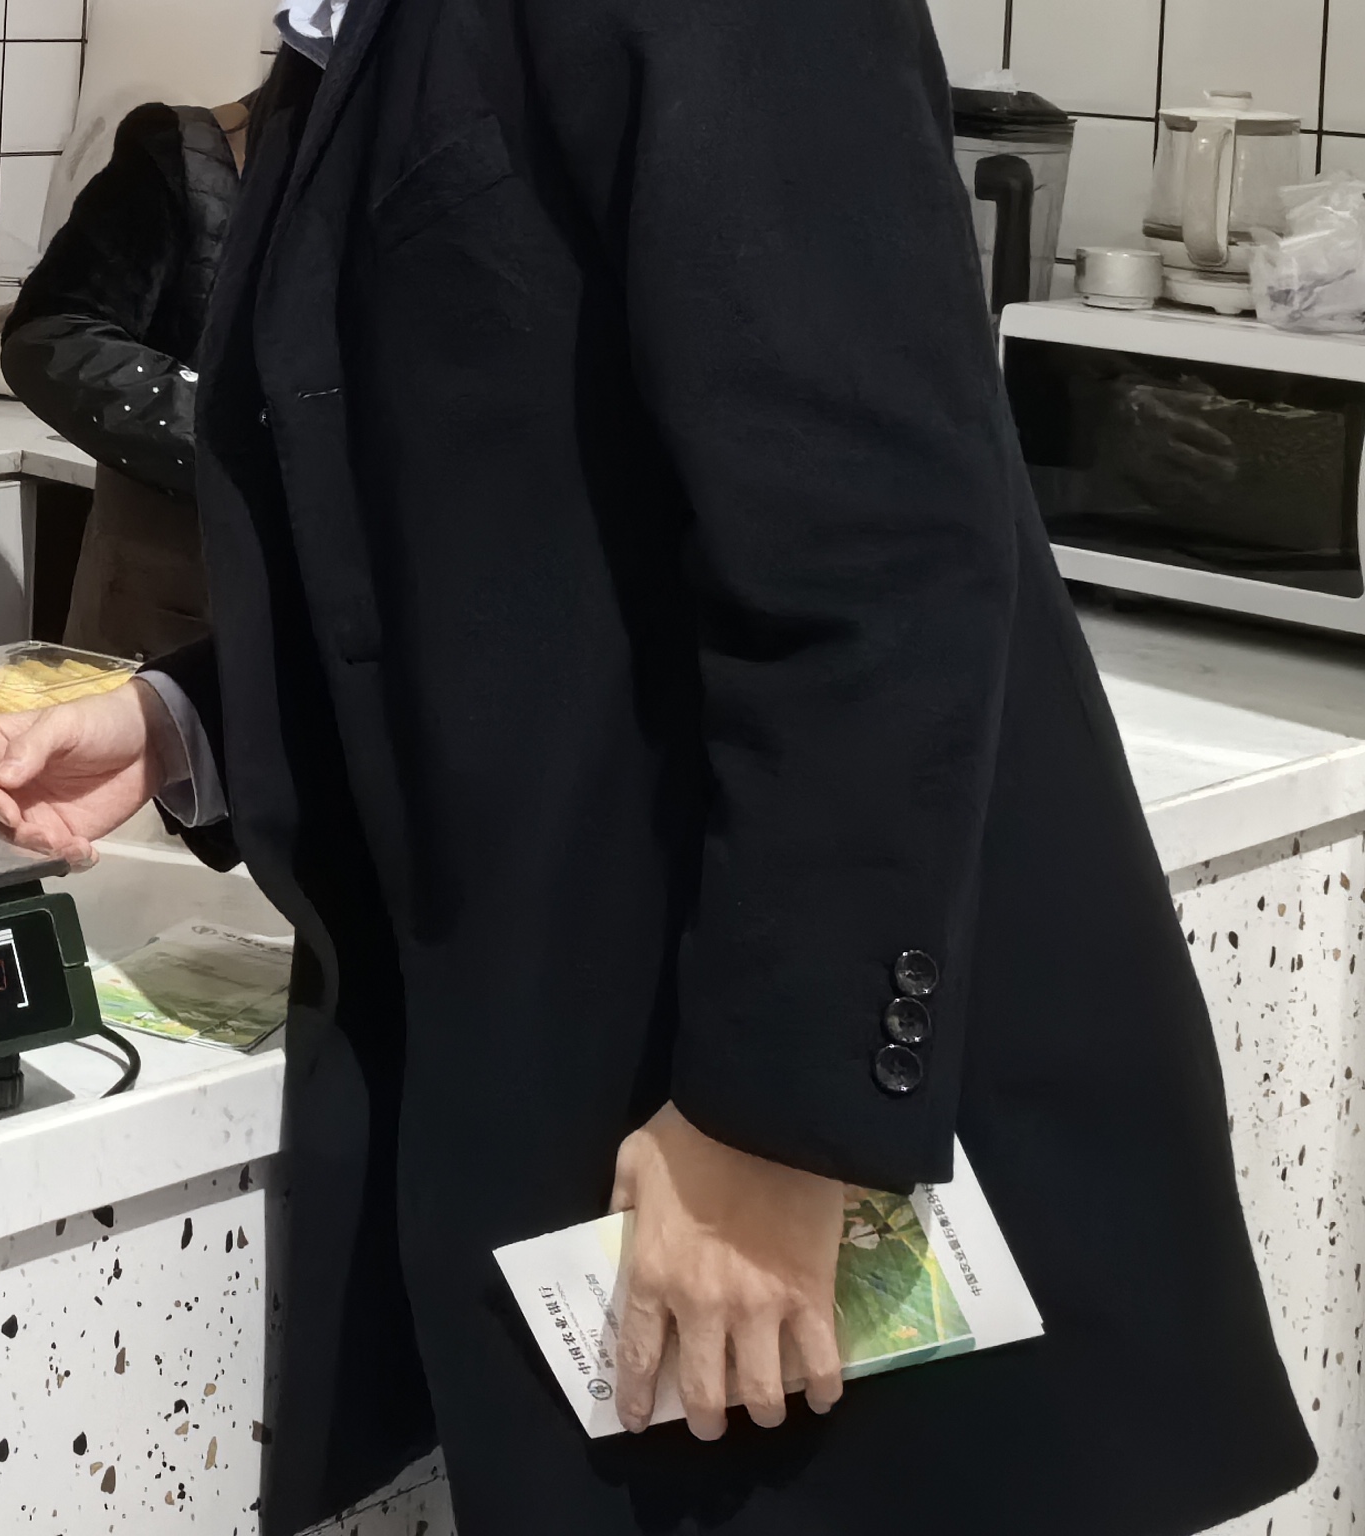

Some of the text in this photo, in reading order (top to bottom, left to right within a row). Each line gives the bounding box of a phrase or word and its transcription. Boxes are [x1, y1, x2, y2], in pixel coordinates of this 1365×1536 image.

[538, 1285, 591, 1376] 中国农业银行
